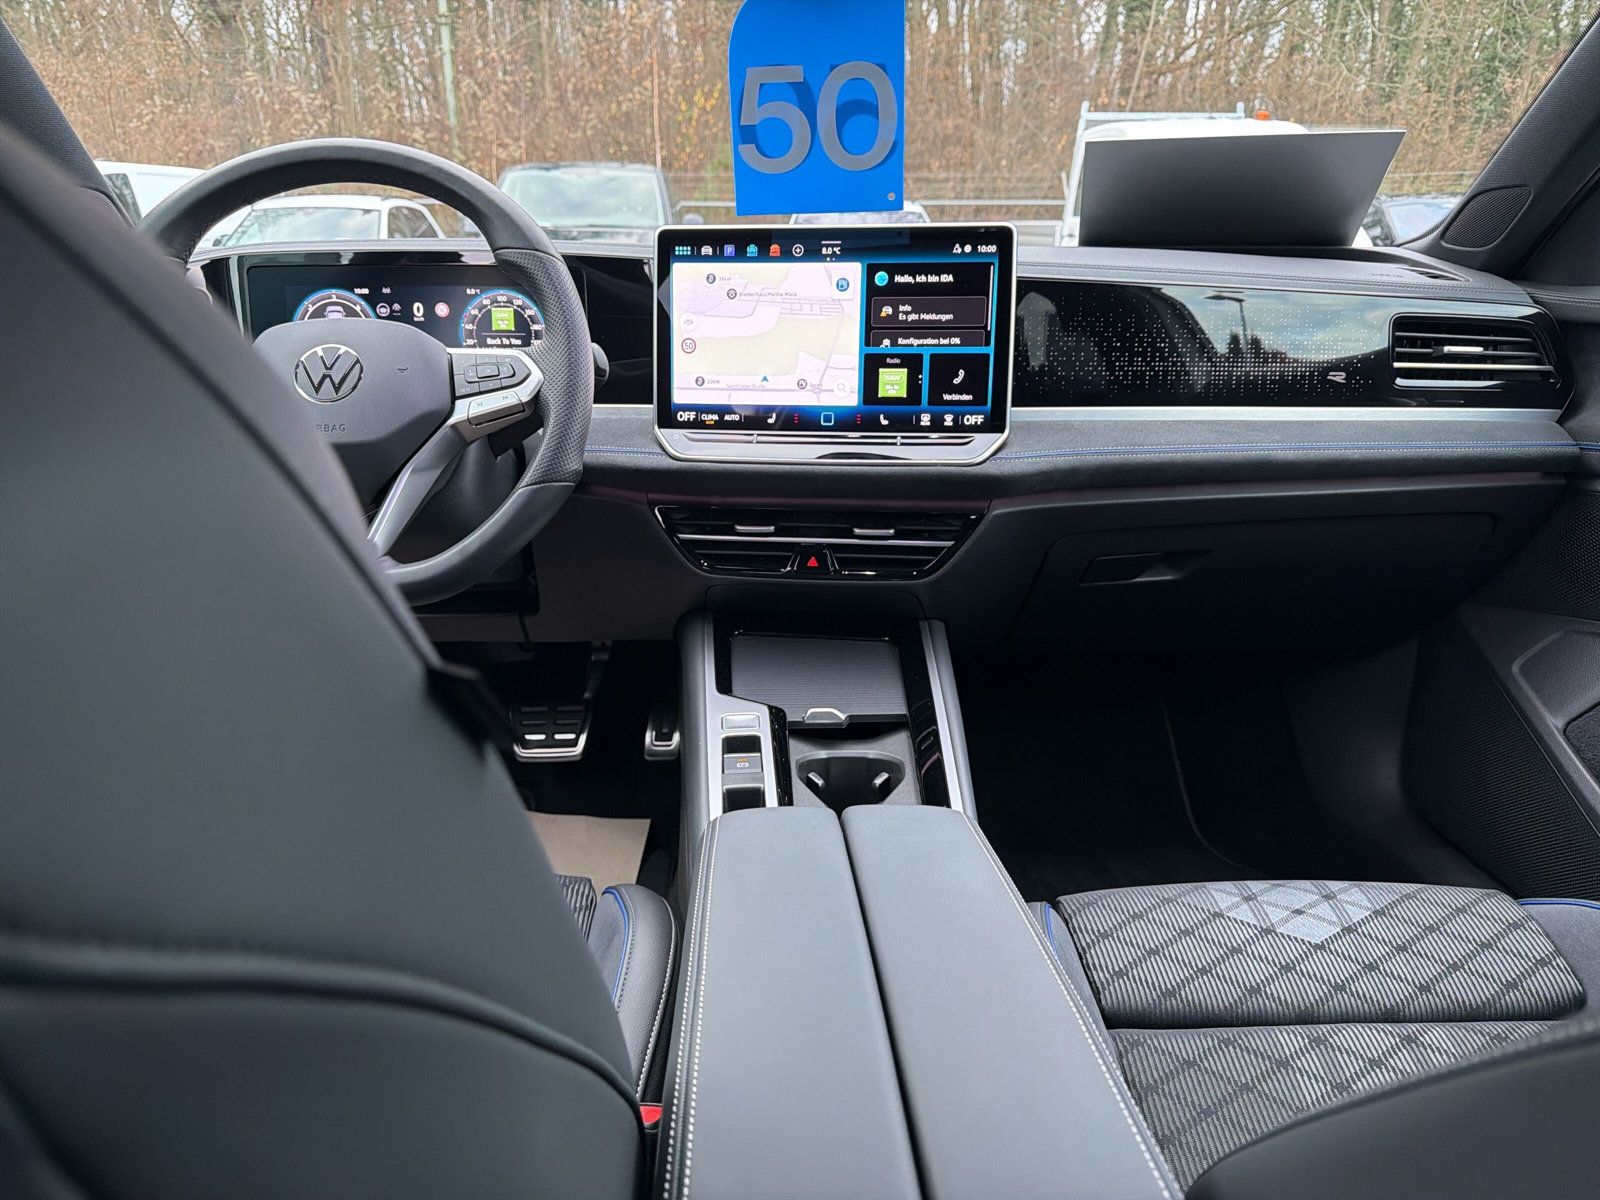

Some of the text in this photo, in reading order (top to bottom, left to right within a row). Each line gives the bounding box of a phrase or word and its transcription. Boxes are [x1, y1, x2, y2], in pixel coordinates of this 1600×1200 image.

[738, 61, 898, 174] 50
[821, 246, 833, 255] 8.0
[977, 244, 997, 253] 10:00
[894, 274, 915, 284] Hallo,
[927, 274, 939, 283] bin
[412, 302, 424, 317] 0
[898, 304, 912, 312] Info
[898, 312, 954, 322] Es gibt Meldungen
[486, 337, 522, 345] Back To You
[684, 341, 694, 349] 50
[897, 336, 961, 347] Konfiguration bei 0%
[942, 393, 973, 401] Verbinden
[676, 411, 697, 422] OFF
[701, 413, 720, 421] CLIMA
[963, 414, 985, 425] OFF
[316, 423, 347, 433] RBAG
